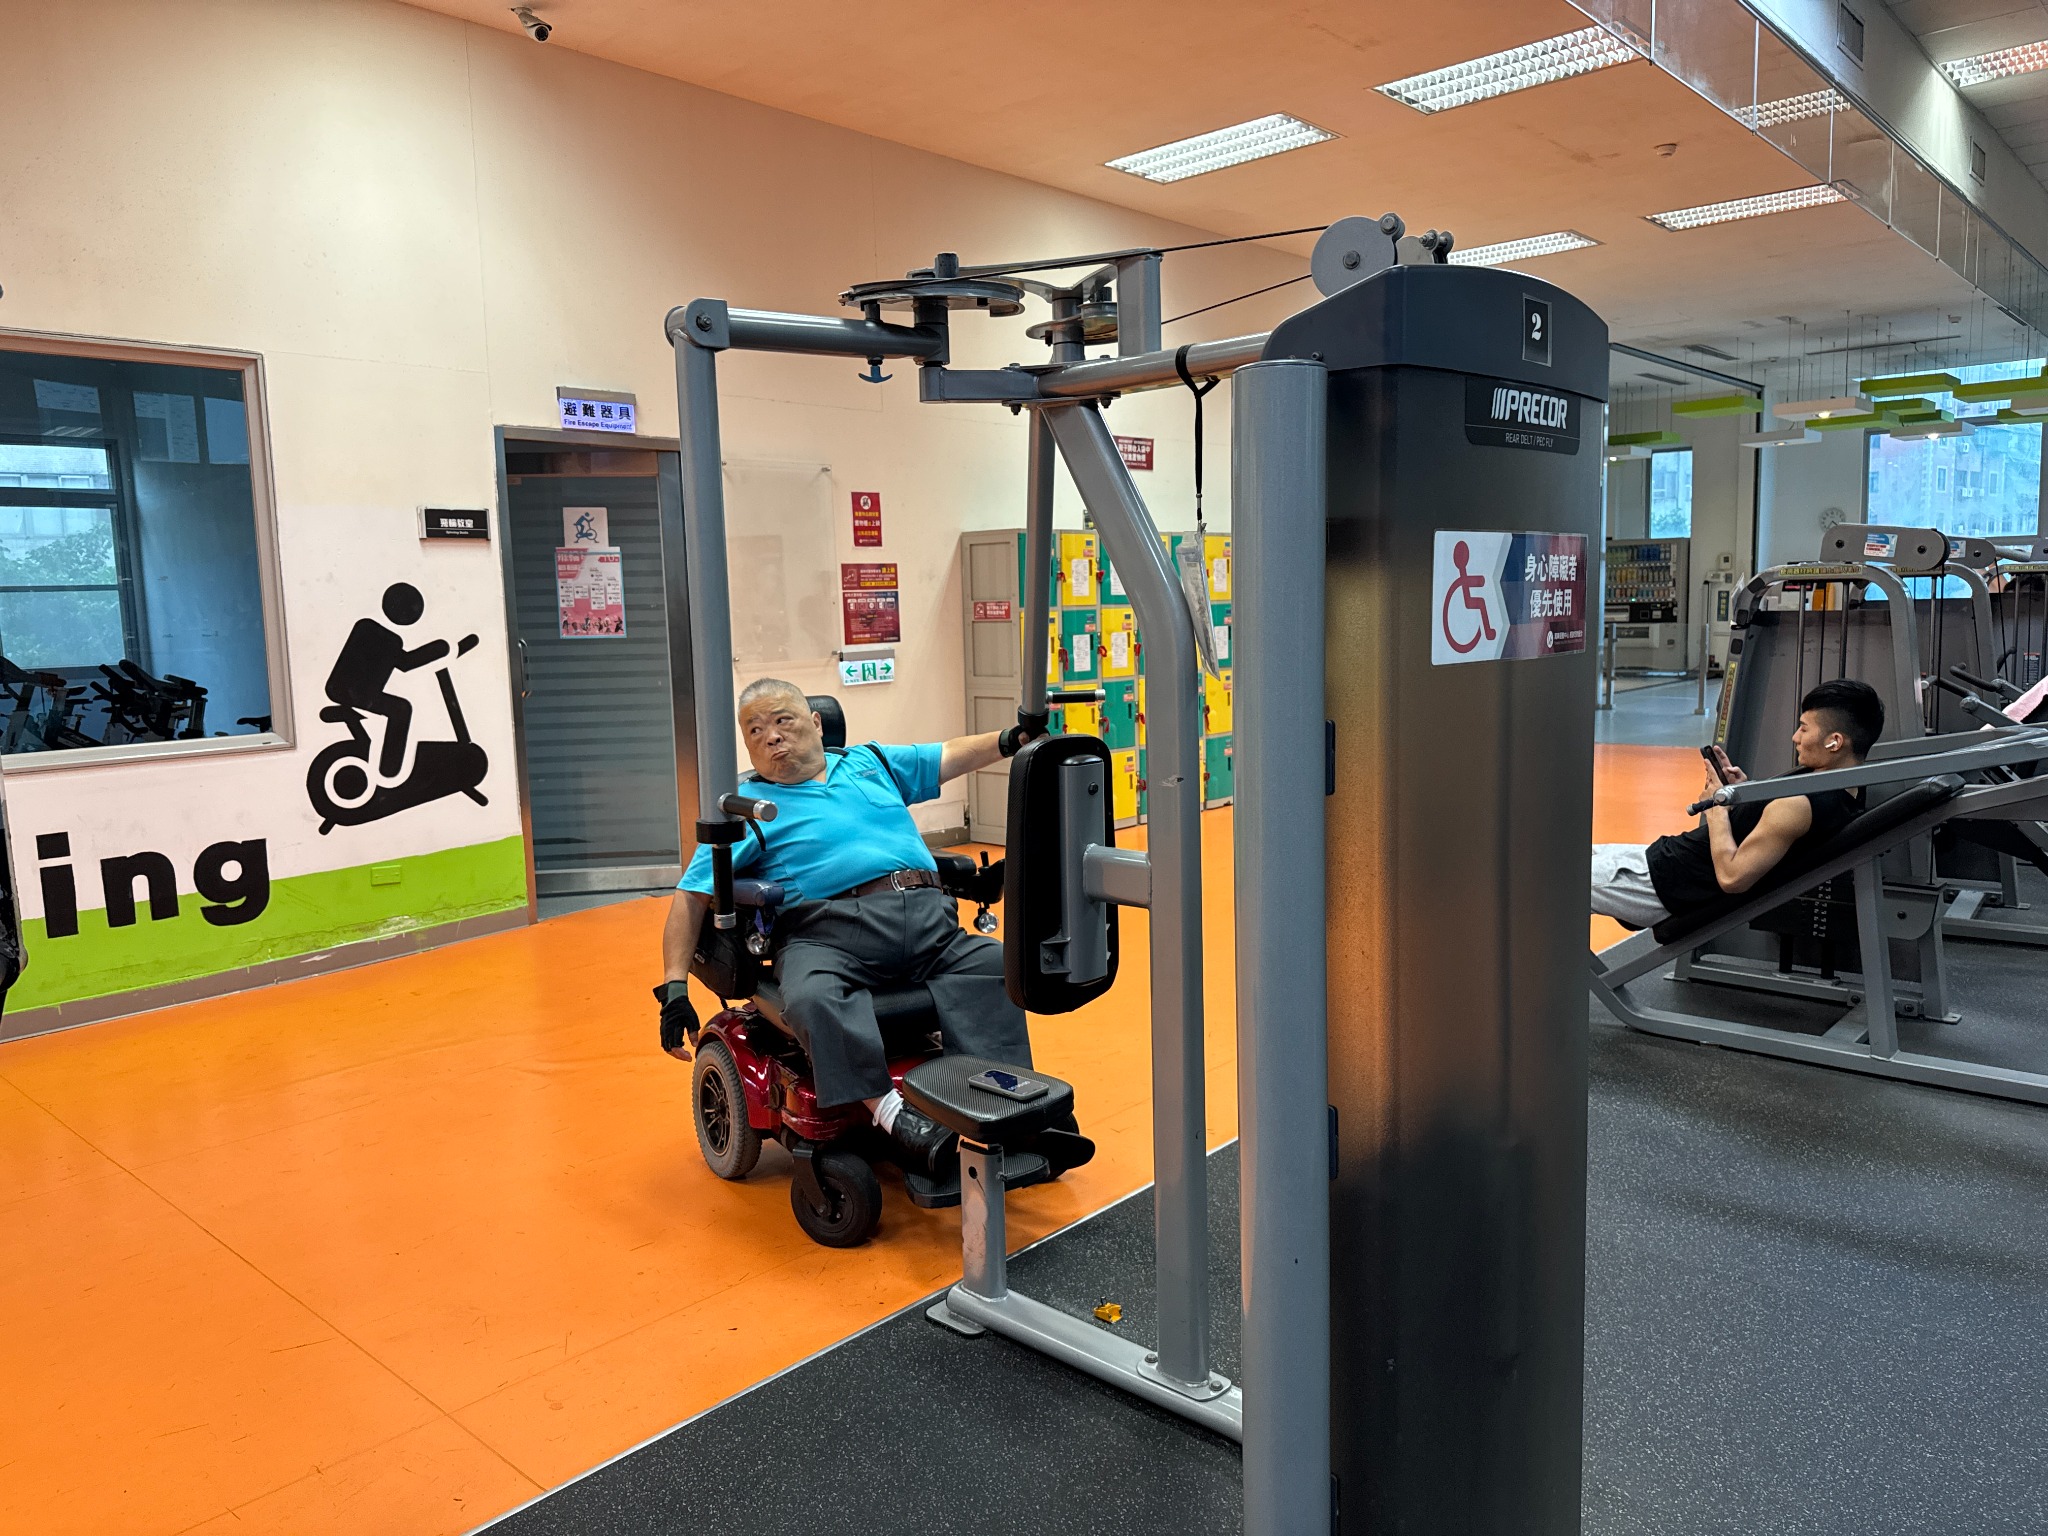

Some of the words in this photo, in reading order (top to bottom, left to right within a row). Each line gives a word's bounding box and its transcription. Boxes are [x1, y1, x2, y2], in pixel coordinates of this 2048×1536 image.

[1531, 312, 1542, 341] 2
[563, 401, 632, 421] 避難器具
[1503, 388, 1568, 430] PRECOR
[564, 418, 576, 426] Fire
[577, 420, 600, 428] Escape
[601, 422, 633, 430] Equipment
[1505, 432, 1520, 444] REAR
[1520, 433, 1533, 446] DELT
[1536, 435, 1546, 447] PEC
[1545, 437, 1554, 448] FLY
[1524, 553, 1578, 583] 身心障礙者
[1530, 588, 1573, 619] 優先使用
[36, 831, 271, 939] ing
